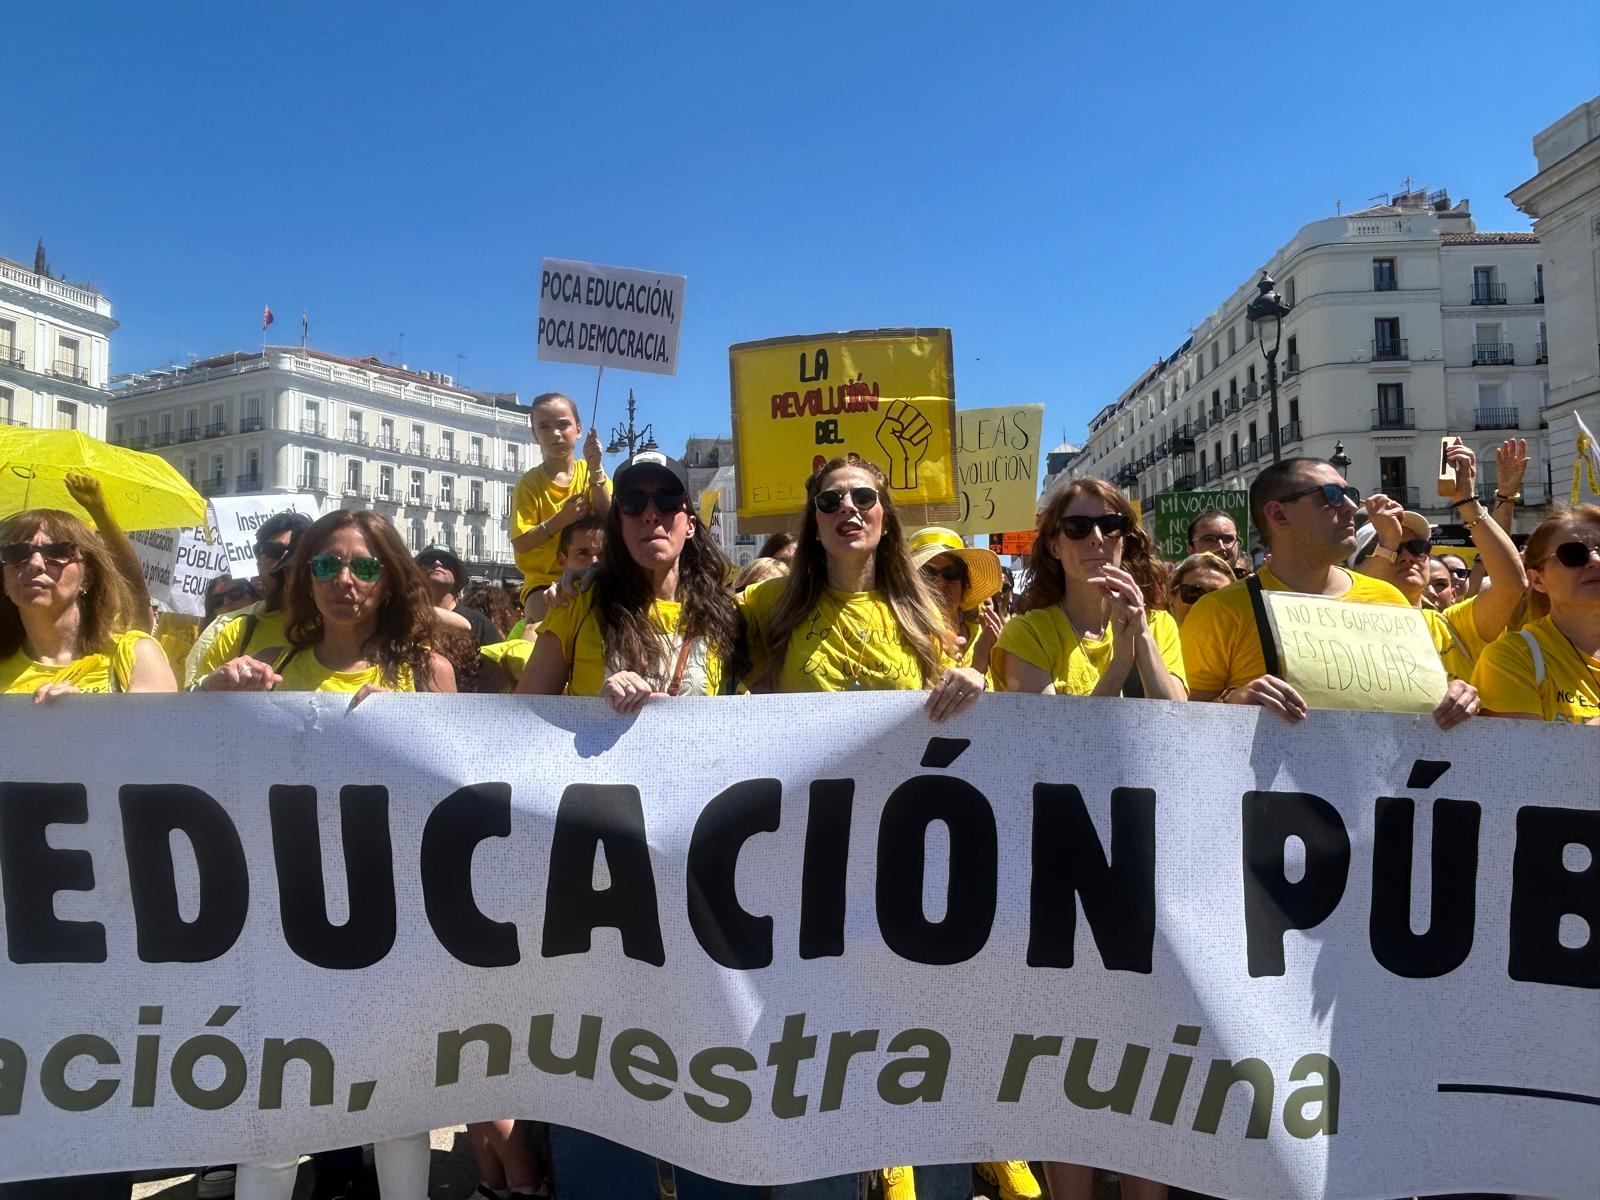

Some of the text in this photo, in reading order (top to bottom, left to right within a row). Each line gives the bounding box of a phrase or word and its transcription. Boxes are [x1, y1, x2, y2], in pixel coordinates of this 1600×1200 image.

[541, 270, 674, 324] POCA EDUCACIÓN,
[537, 317, 669, 363] POCA DEMOCRACIA.
[799, 349, 829, 382] LA
[815, 419, 844, 445] DEL
[176, 544, 231, 573] PÚBLIC
[1285, 604, 1311, 624] NO
[1317, 607, 1337, 628] ES
[1293, 630, 1432, 698] ES EDUCAR
[0, 736, 1600, 989] EDUCACIÓN PÚB
[434, 1012, 951, 1123] nuestra
[997, 1024, 1341, 1140] ruina
